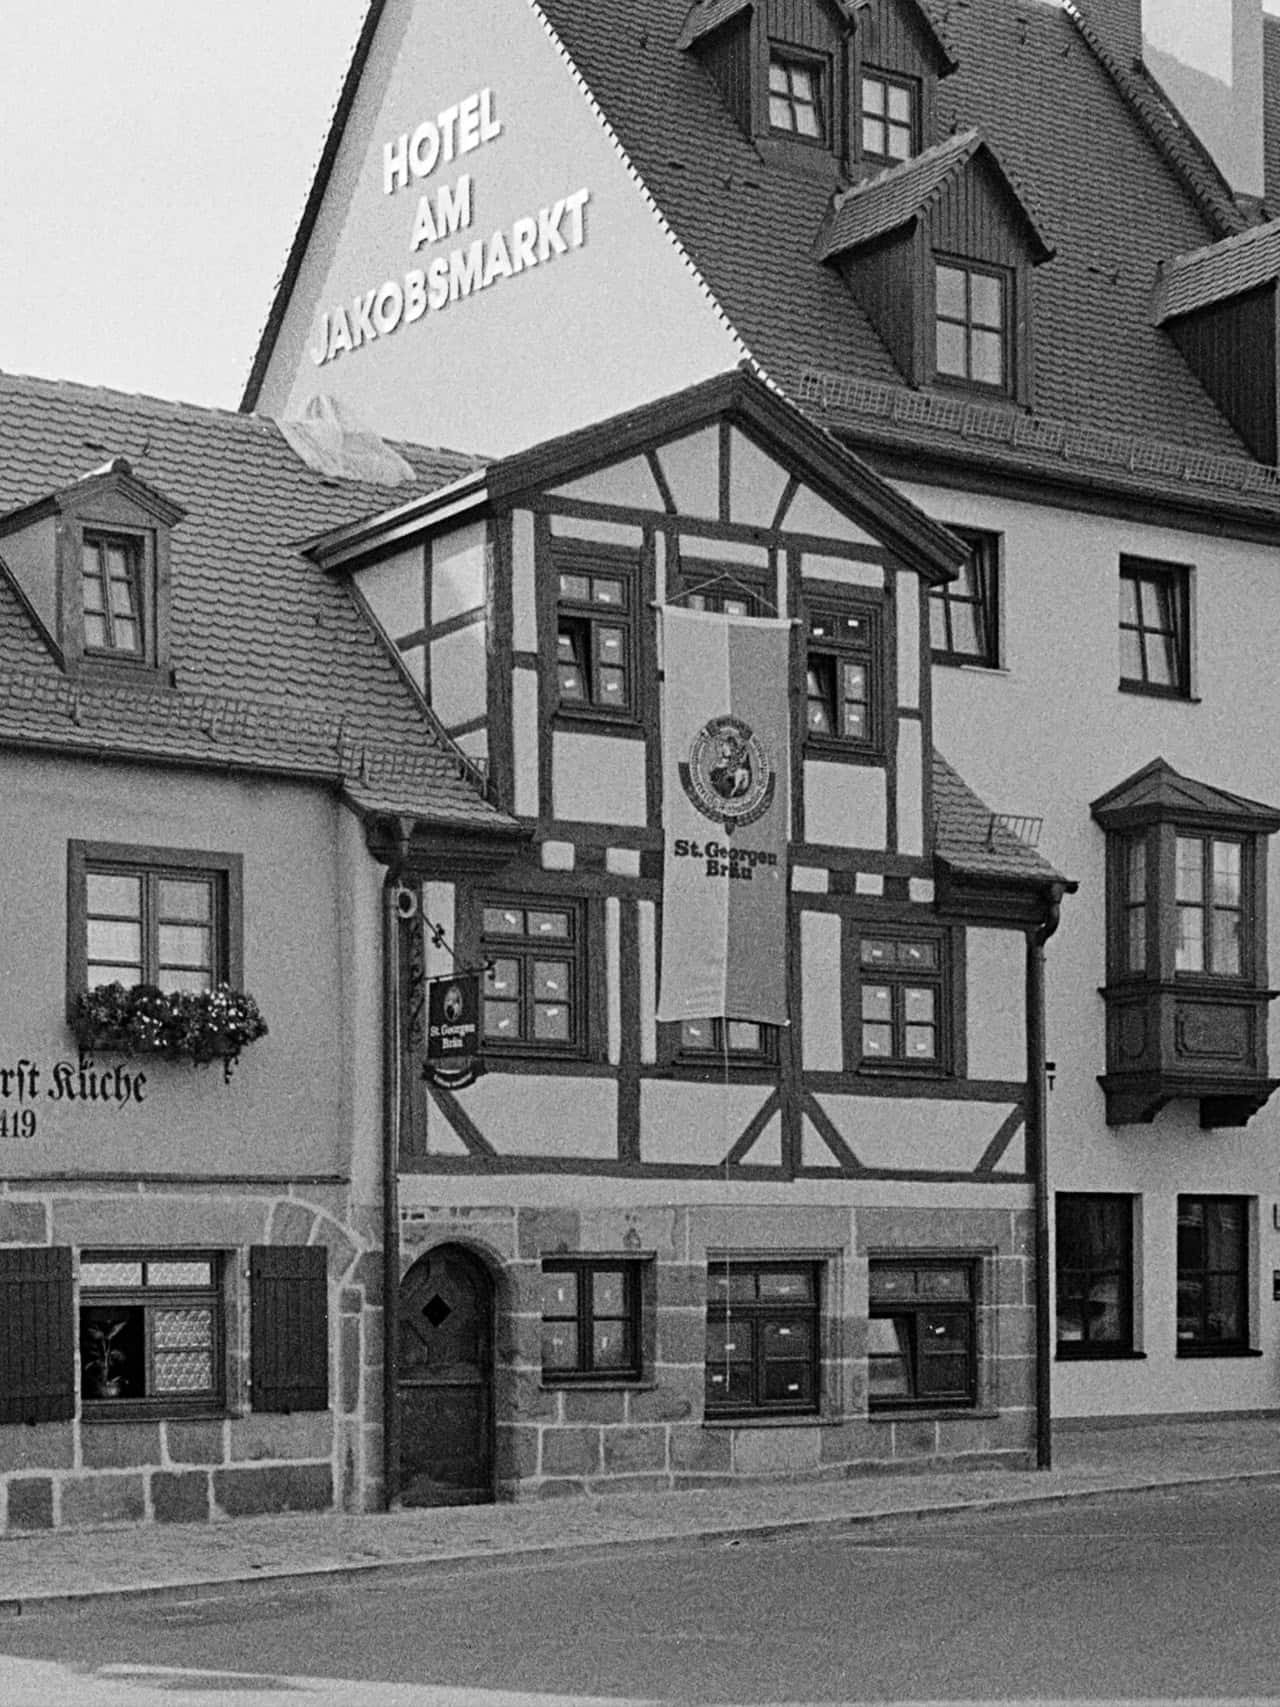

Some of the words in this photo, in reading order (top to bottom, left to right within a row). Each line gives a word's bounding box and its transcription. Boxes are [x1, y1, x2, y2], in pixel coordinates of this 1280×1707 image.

[382, 87, 501, 195] HOTEL
[411, 174, 471, 251] AM
[310, 187, 591, 366] JAKOBSMARKT
